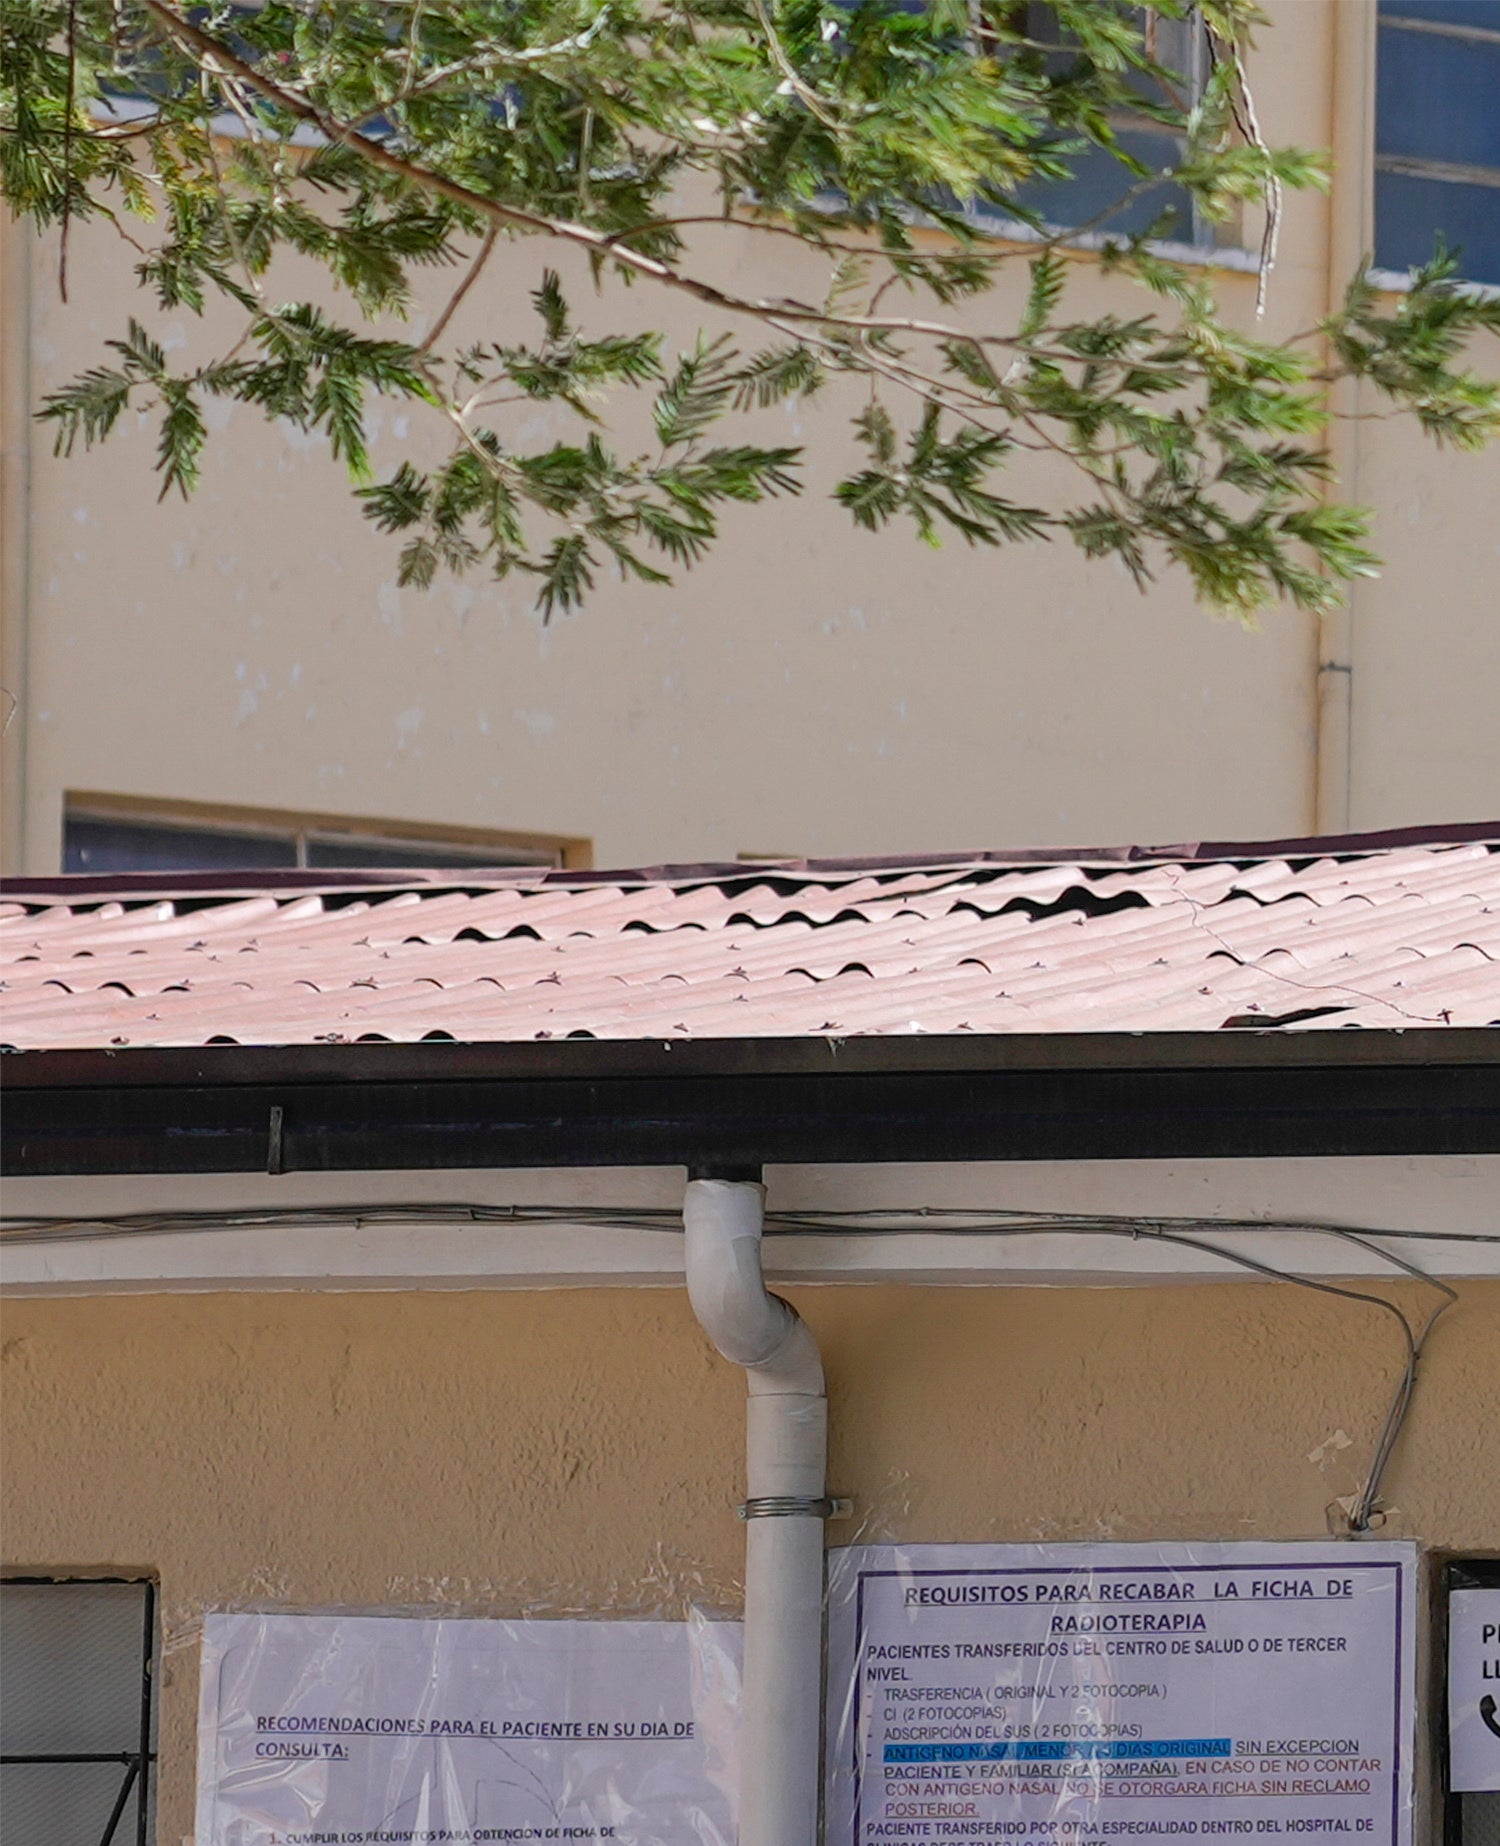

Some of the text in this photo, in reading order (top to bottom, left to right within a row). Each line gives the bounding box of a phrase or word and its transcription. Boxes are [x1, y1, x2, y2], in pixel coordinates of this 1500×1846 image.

[905, 1580, 1353, 1604] REQUISITOS PARA RECABAR LA FICHA DE
[1051, 1614, 1207, 1632] RADIOTERAPIA
[867, 1638, 1346, 1659] PACIENTES TRANSFERIDOS DEL CENTRO DE SALUD O DE TERCER
[257, 1717, 694, 1737] RECOMENDACIONES PARA EL PACIENTE EN SU DIA DE
[256, 1743, 349, 1757] CONSULTA:
[1236, 1740, 1359, 1754] SIN EXCEPCION
[1186, 1759, 1381, 1774] EN CASO DE NO CONTAR
[1286, 1819, 1351, 1832] HOSPITAL
[342, 1833, 362, 1843] LOS
[366, 1831, 436, 1843] REQUISITOS
[439, 1830, 470, 1841] PARA
[474, 1829, 541, 1840] OBTENCION
[545, 1829, 559, 1838] DE
[564, 1828, 595, 1838] FICHA
[600, 1828, 615, 1837] DE
